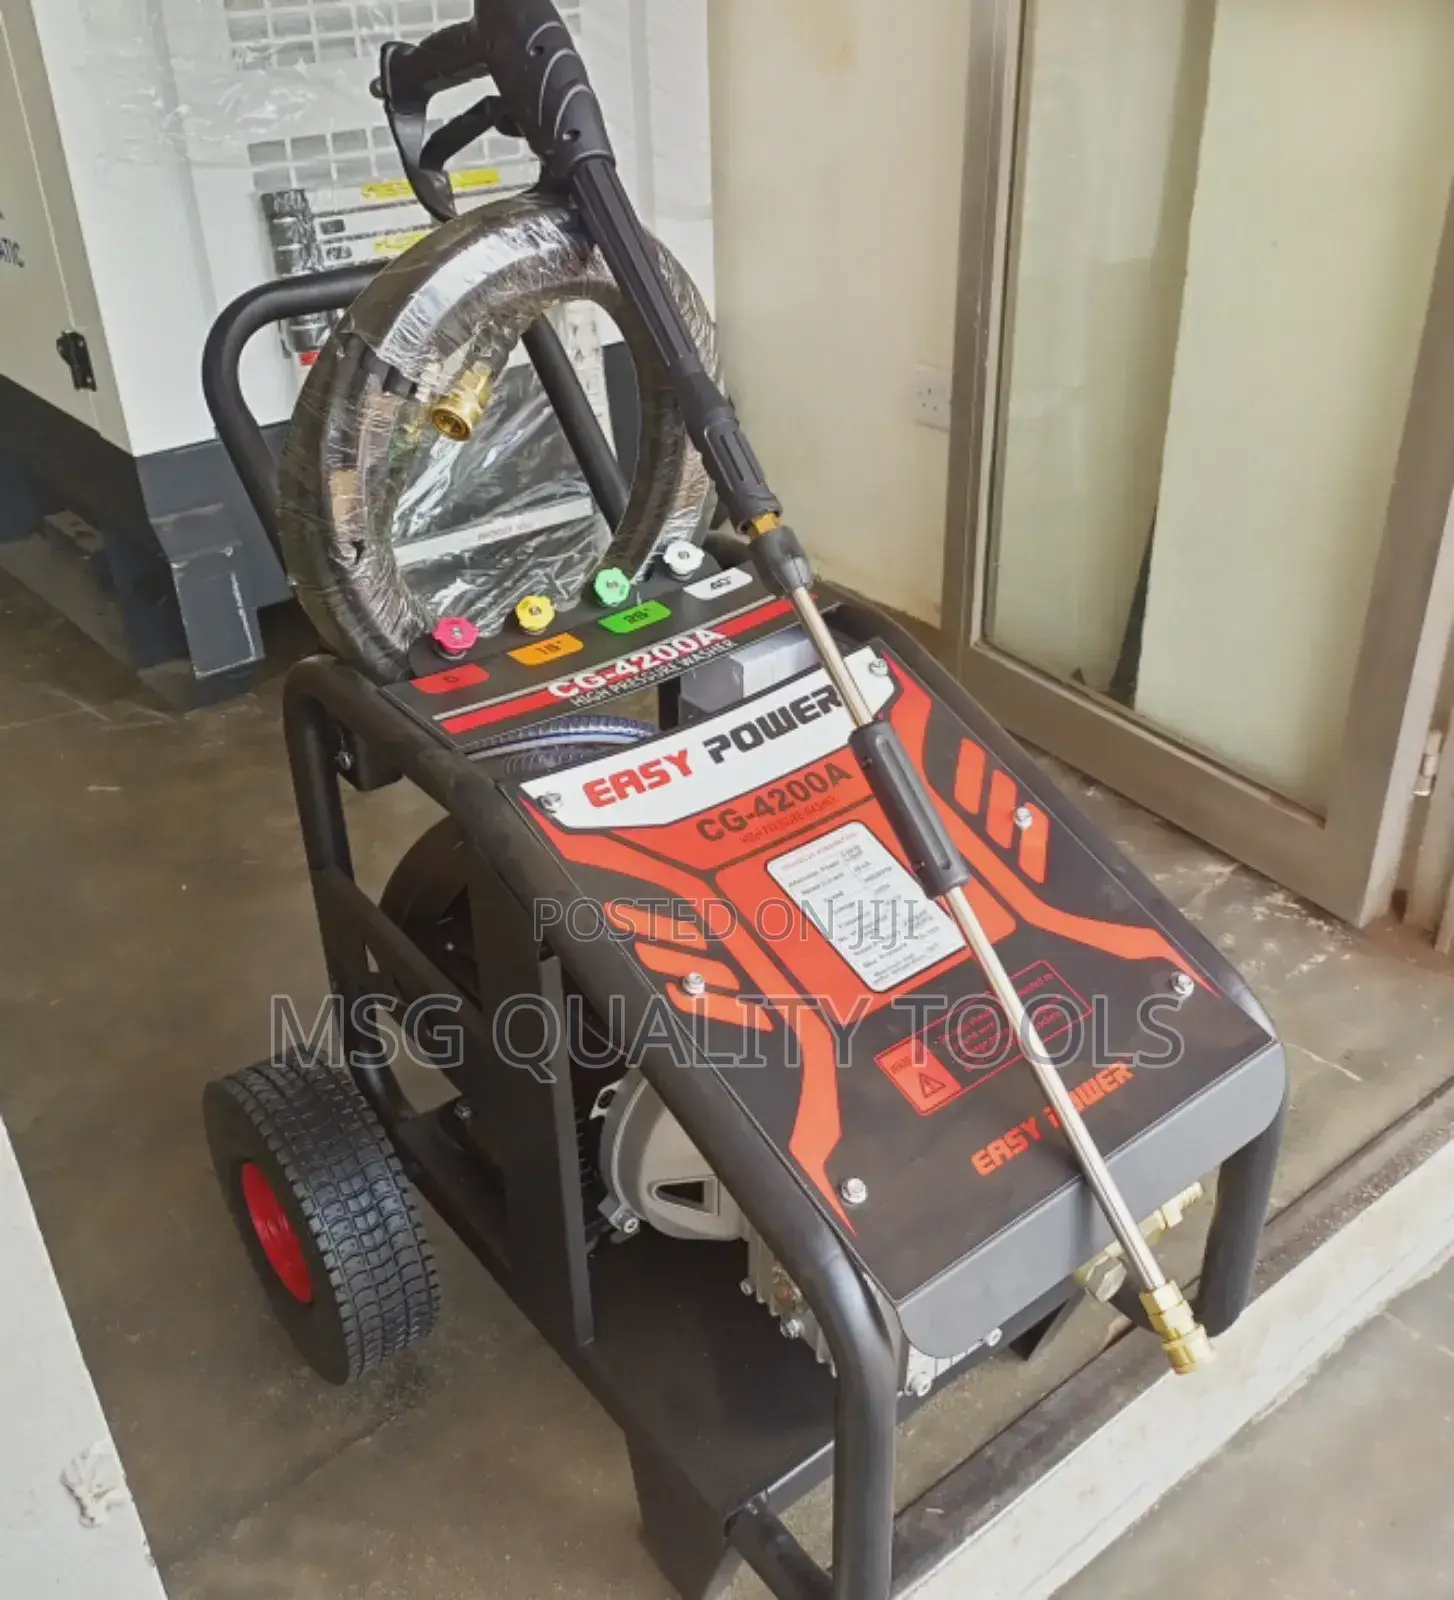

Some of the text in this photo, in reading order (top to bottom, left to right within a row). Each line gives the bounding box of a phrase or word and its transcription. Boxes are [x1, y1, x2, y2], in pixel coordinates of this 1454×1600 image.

[548, 628, 727, 698] CG-4200A
[582, 683, 844, 809] EASY POWER
[696, 762, 853, 842] CG-4200A
[971, 1060, 1135, 1177] EASY PWER
